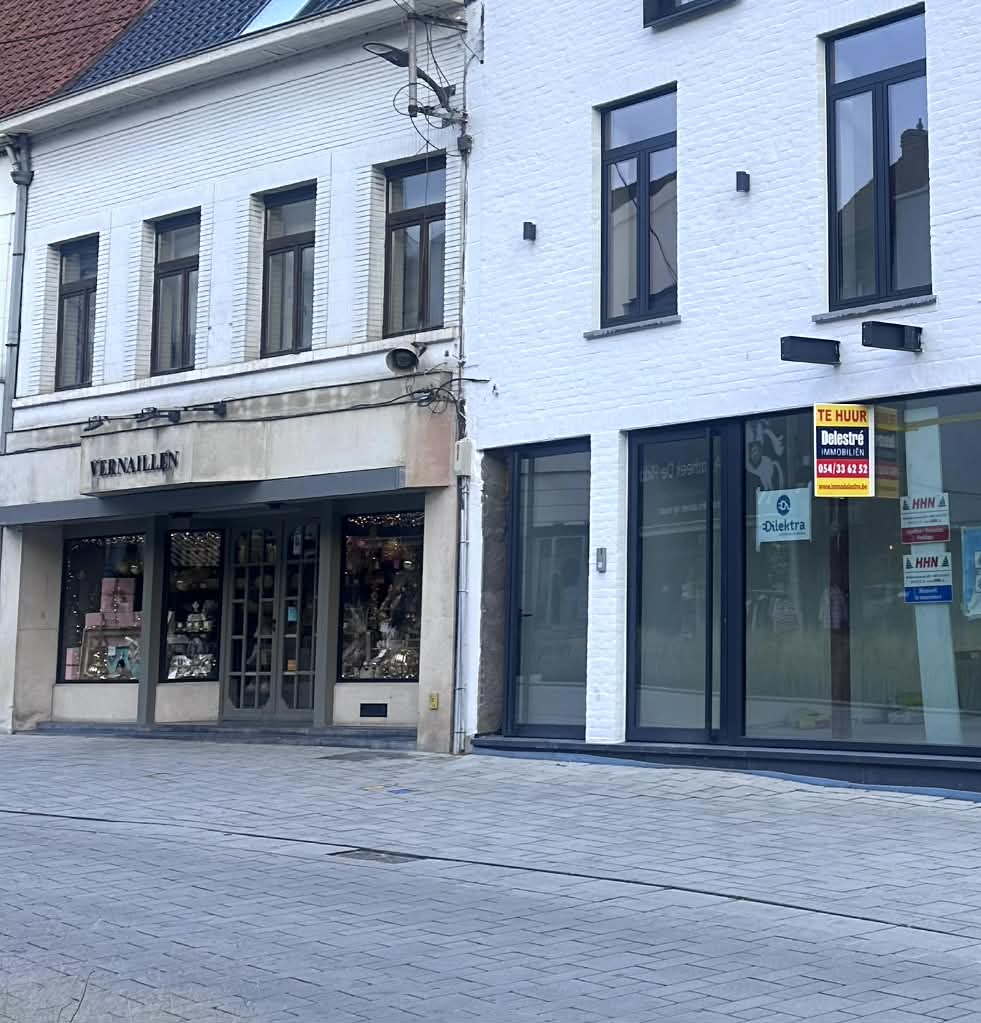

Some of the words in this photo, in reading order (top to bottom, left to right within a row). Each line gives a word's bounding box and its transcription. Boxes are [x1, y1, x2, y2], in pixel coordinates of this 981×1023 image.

[818, 409, 832, 422] TE
[836, 409, 867, 422] HUUR
[821, 430, 864, 446] Delestré
[821, 447, 865, 457] IMMOBILIËN
[90, 450, 179, 477] VERNAILLEN
[818, 463, 846, 474] 054/33
[847, 463, 857, 474] 62
[858, 463, 868, 474] 52
[912, 497, 936, 510] HHN
[762, 520, 806, 532] Dilektra
[915, 556, 938, 569] HHN
